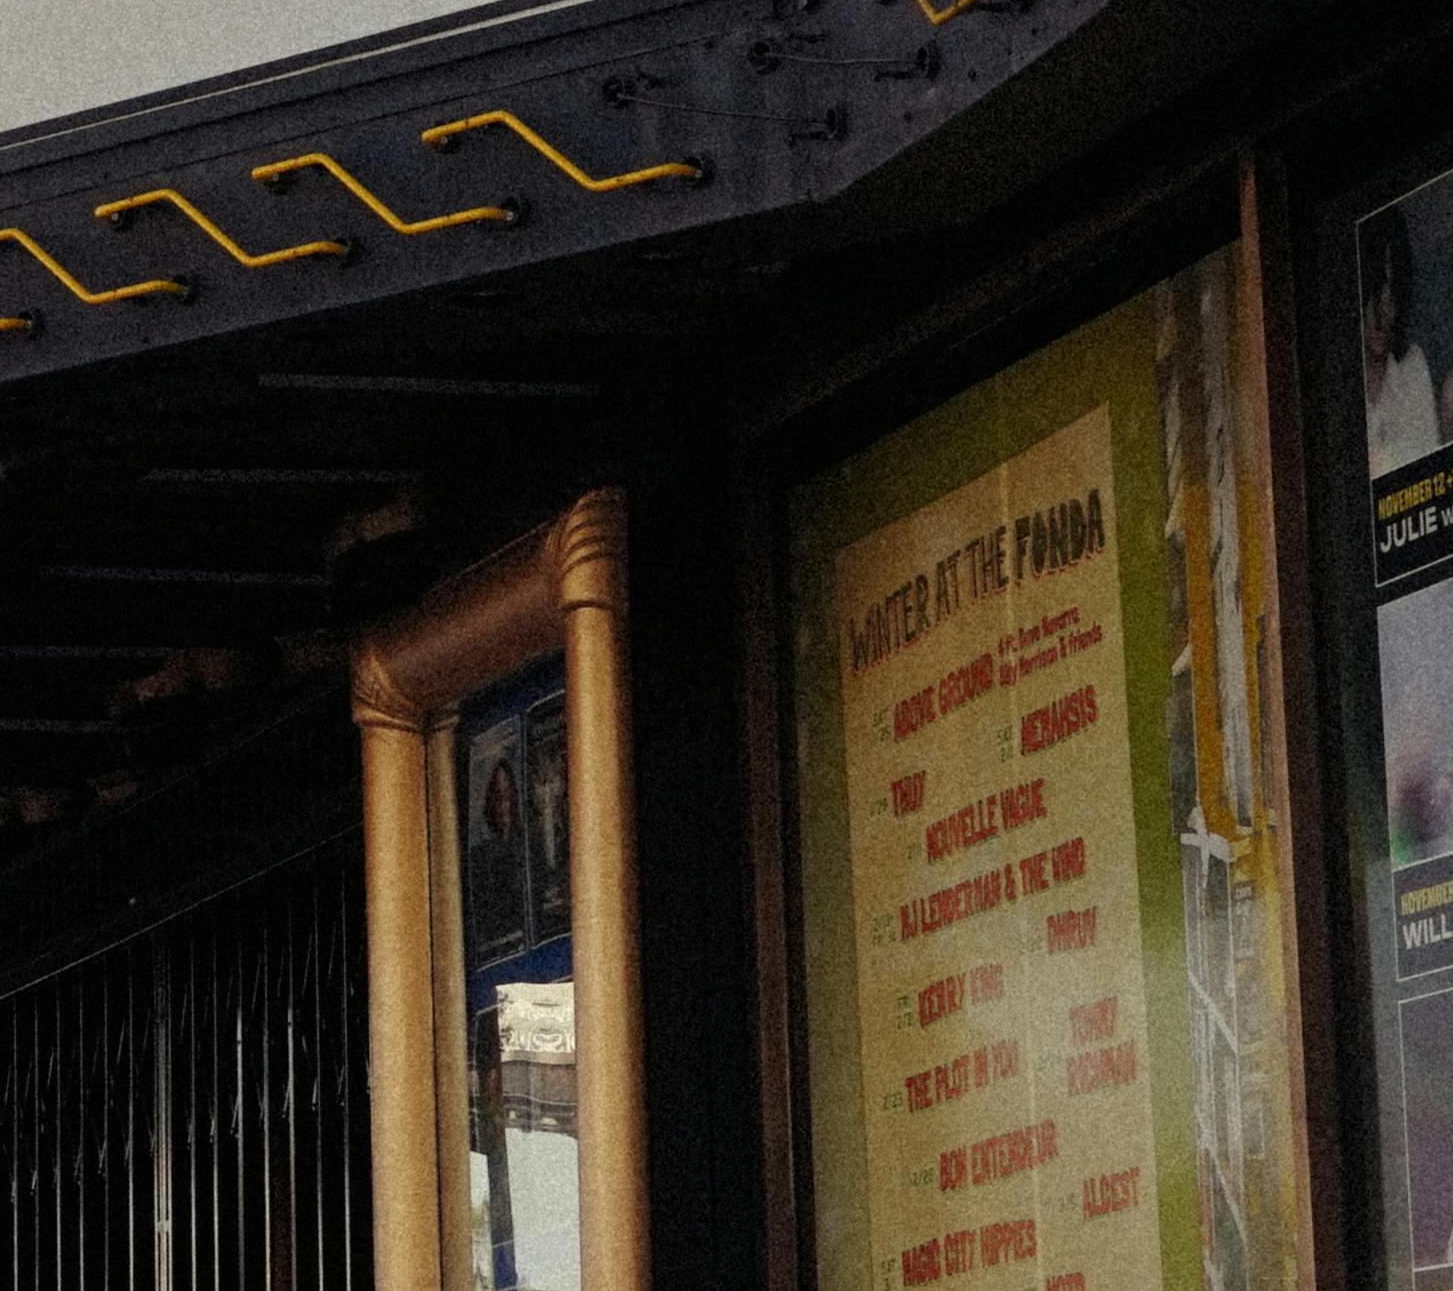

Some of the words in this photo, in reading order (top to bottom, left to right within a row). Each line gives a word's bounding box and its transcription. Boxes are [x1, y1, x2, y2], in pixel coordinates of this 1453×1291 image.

[1015, 489, 1105, 587] FONDA
[1379, 507, 1441, 554] JULIE
[1402, 915, 1453, 949] WILL
